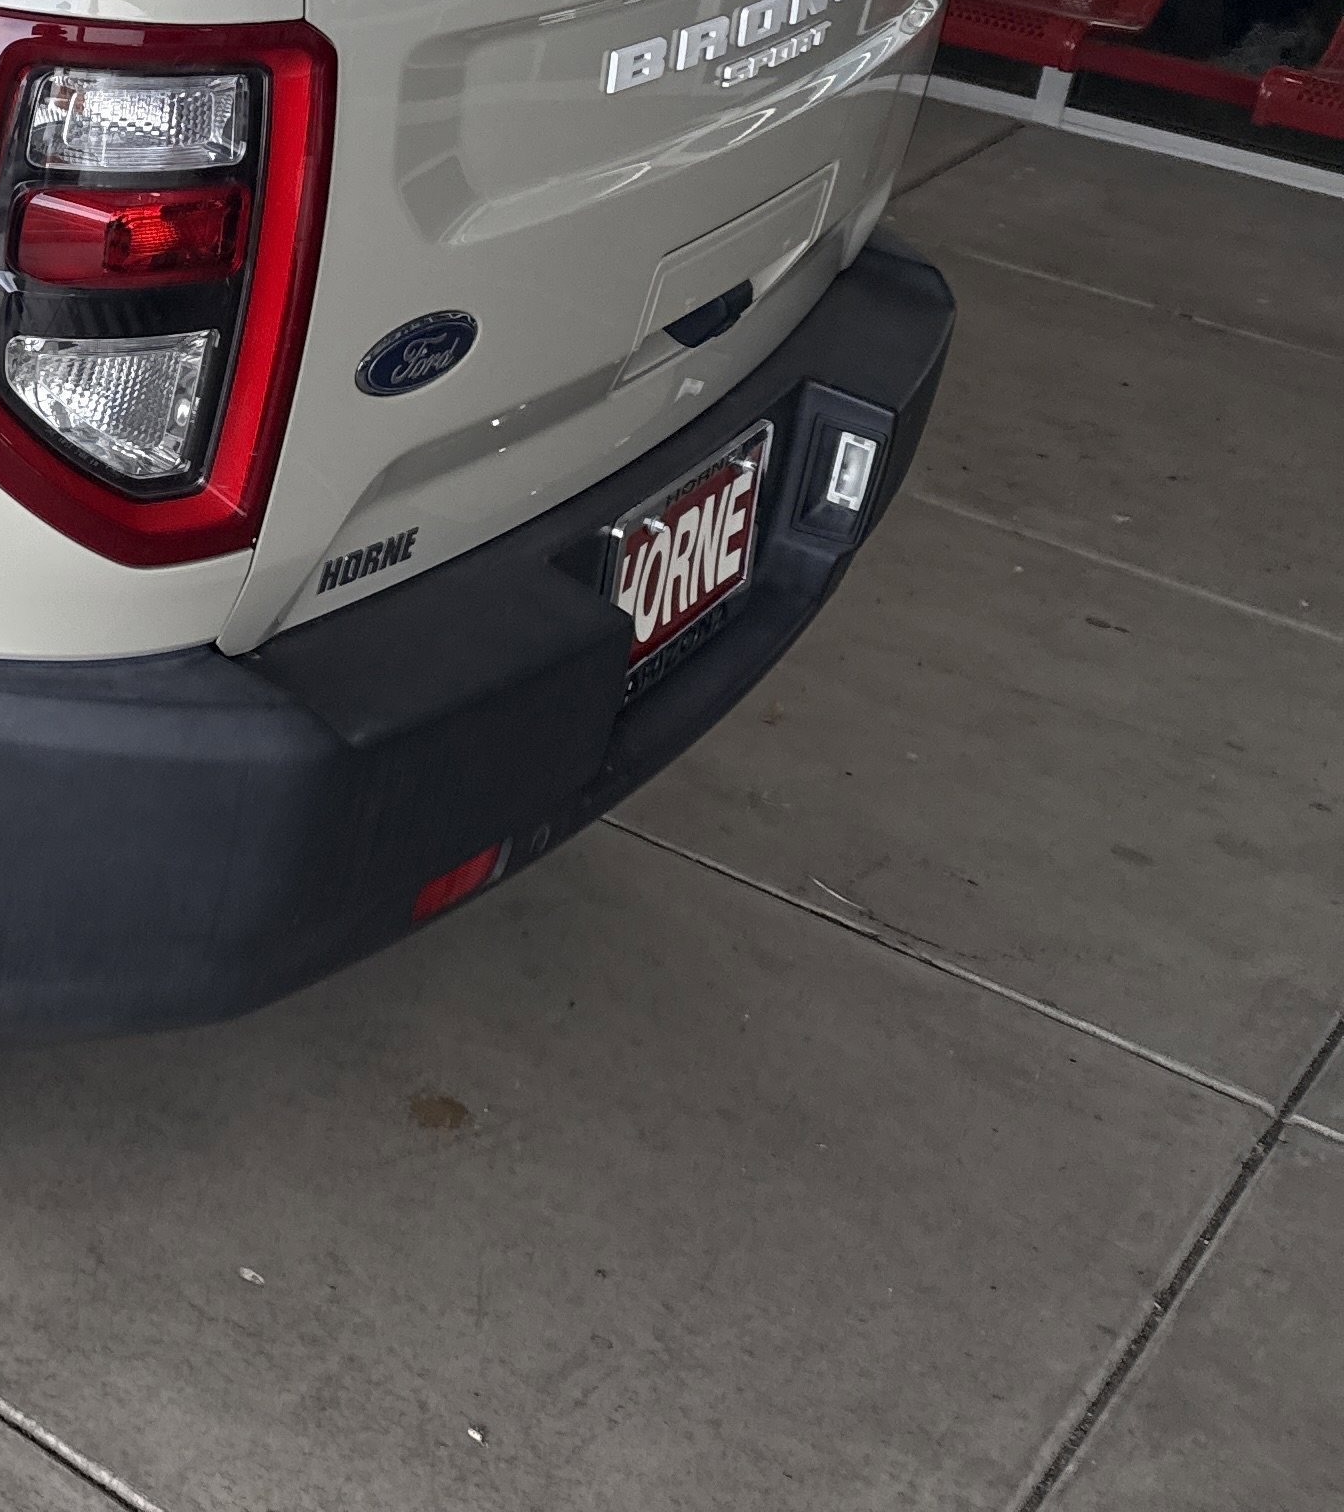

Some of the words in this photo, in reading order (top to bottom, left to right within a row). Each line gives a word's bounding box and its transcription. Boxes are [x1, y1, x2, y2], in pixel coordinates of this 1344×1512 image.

[721, 22, 830, 88] SPORT
[390, 332, 460, 386] Ford
[316, 526, 419, 595] HORNE
[618, 471, 754, 643] HORNE
